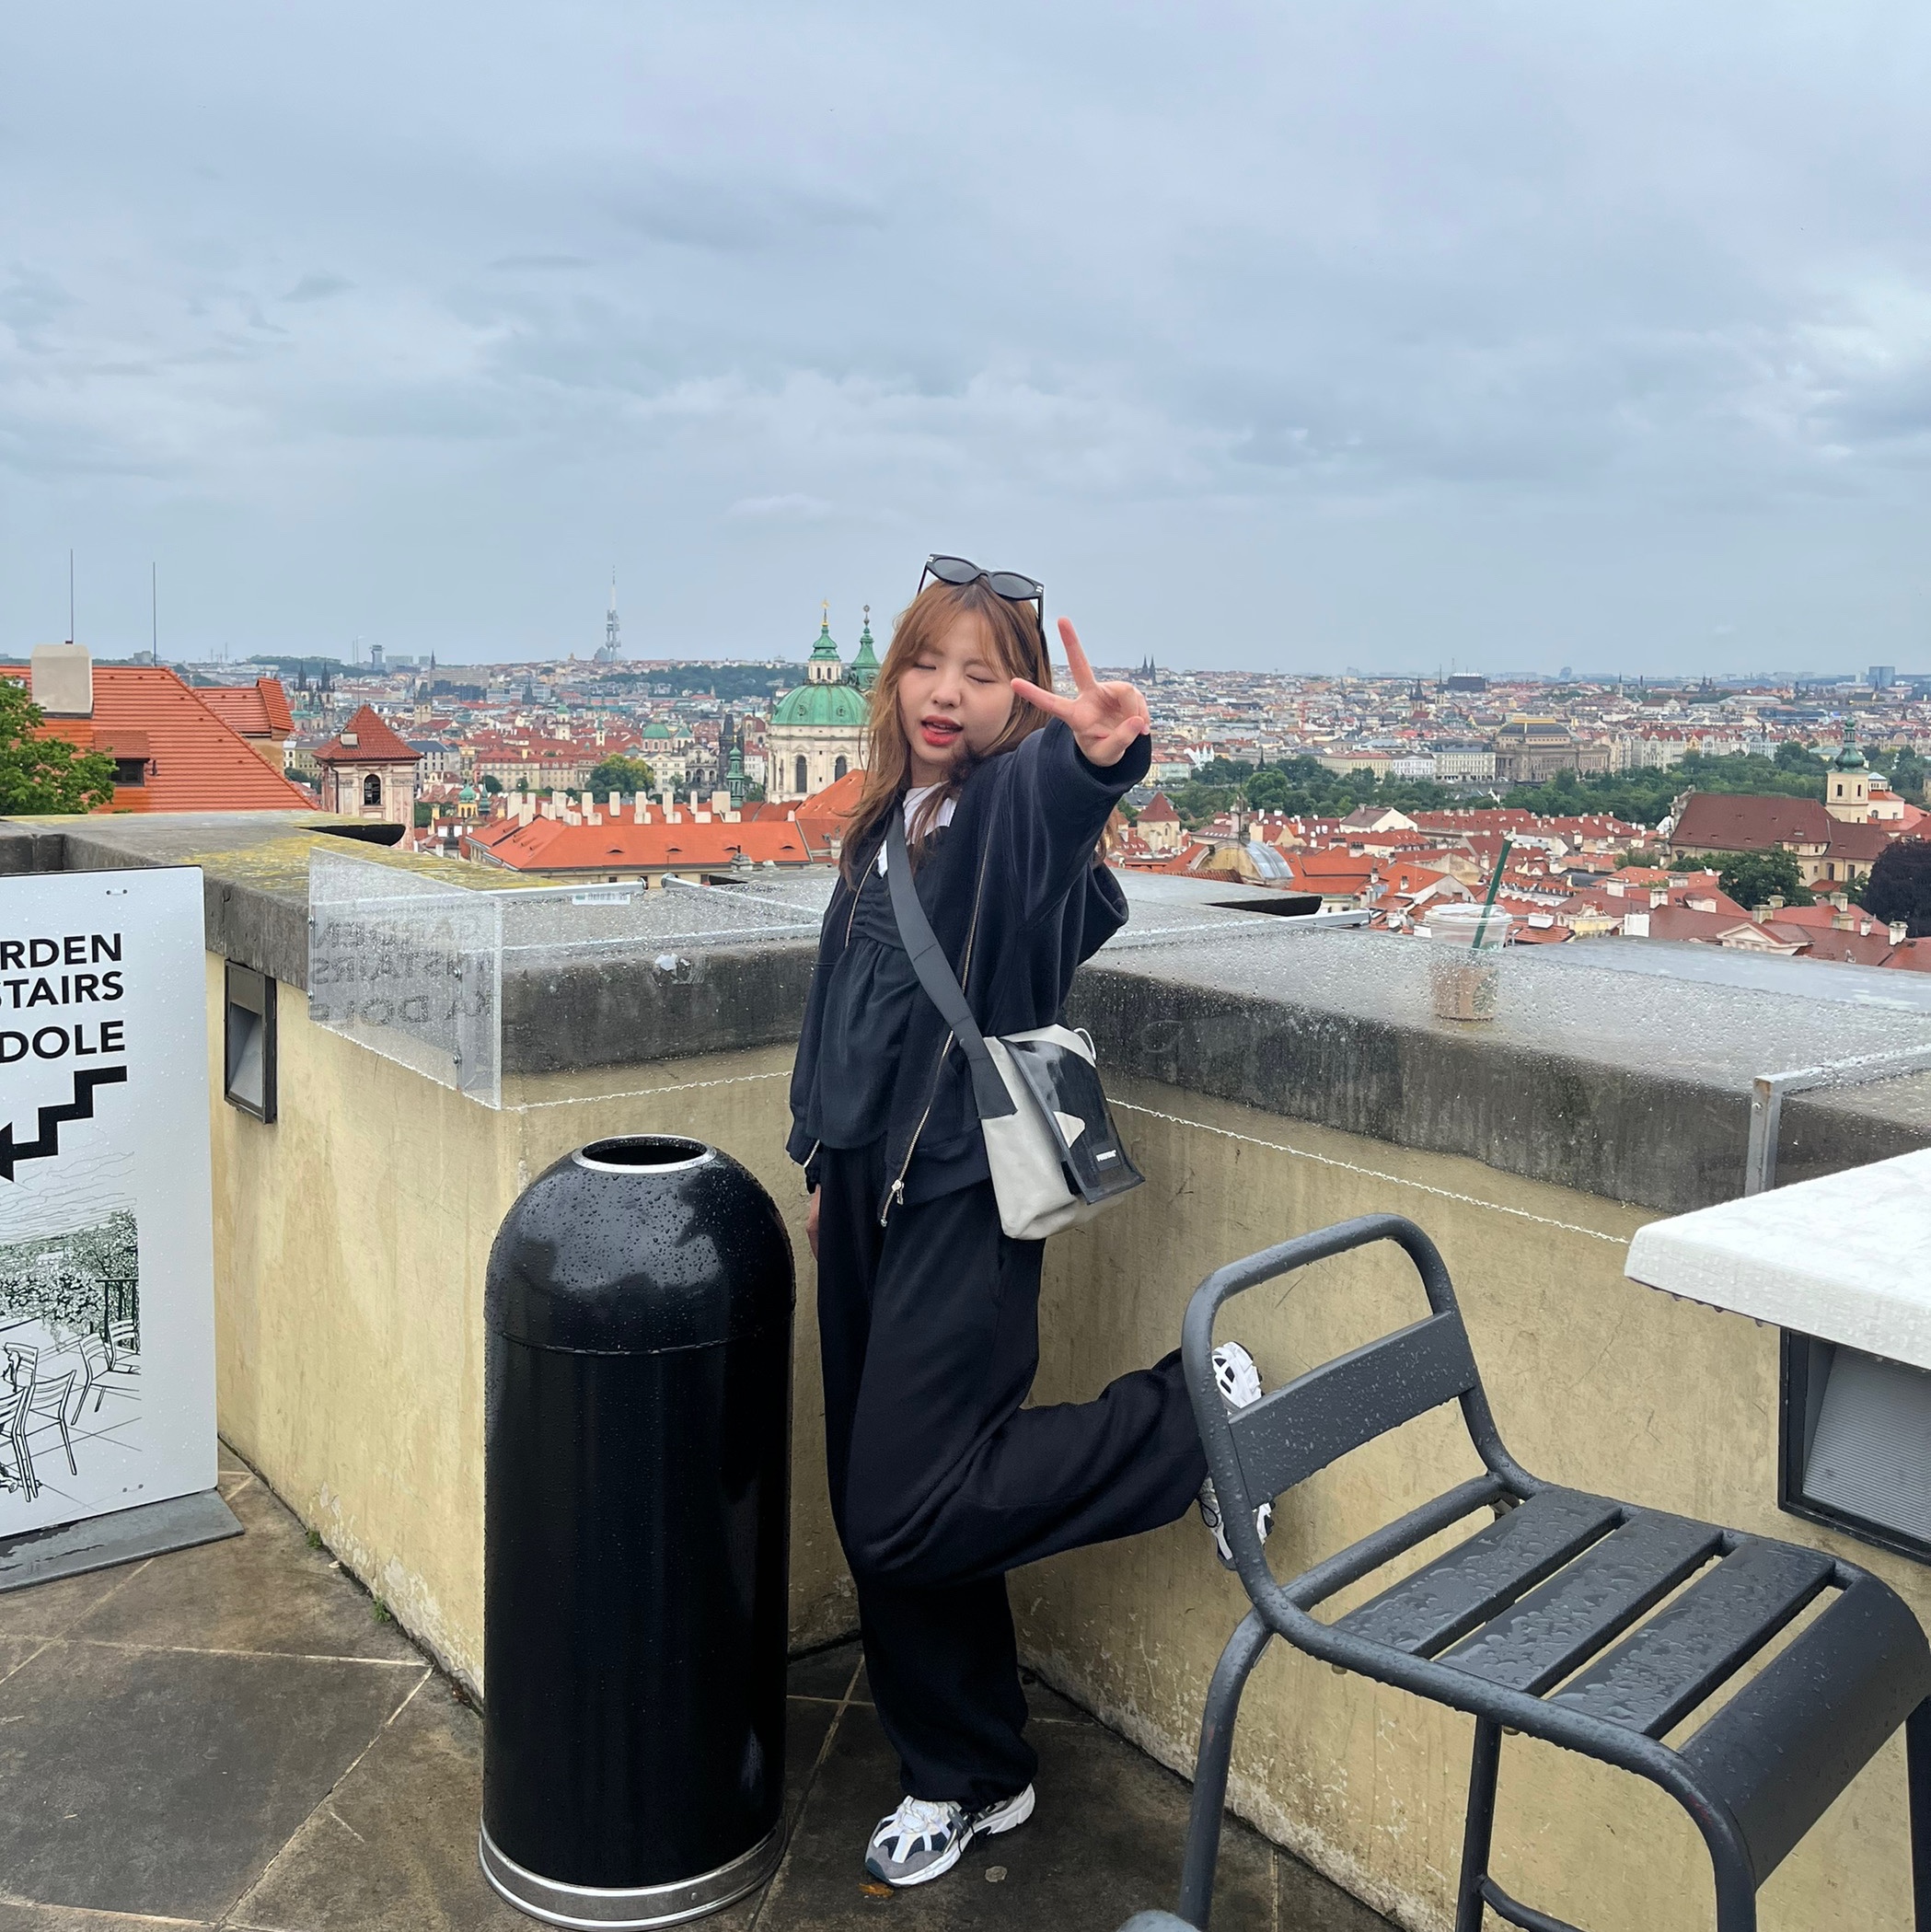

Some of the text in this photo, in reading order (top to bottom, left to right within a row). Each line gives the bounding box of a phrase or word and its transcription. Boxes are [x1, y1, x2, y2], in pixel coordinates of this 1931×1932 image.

[0, 933, 122, 969] RDEN
[0, 971, 124, 1009] TAIRS
[0, 1020, 126, 1063] DOLE
